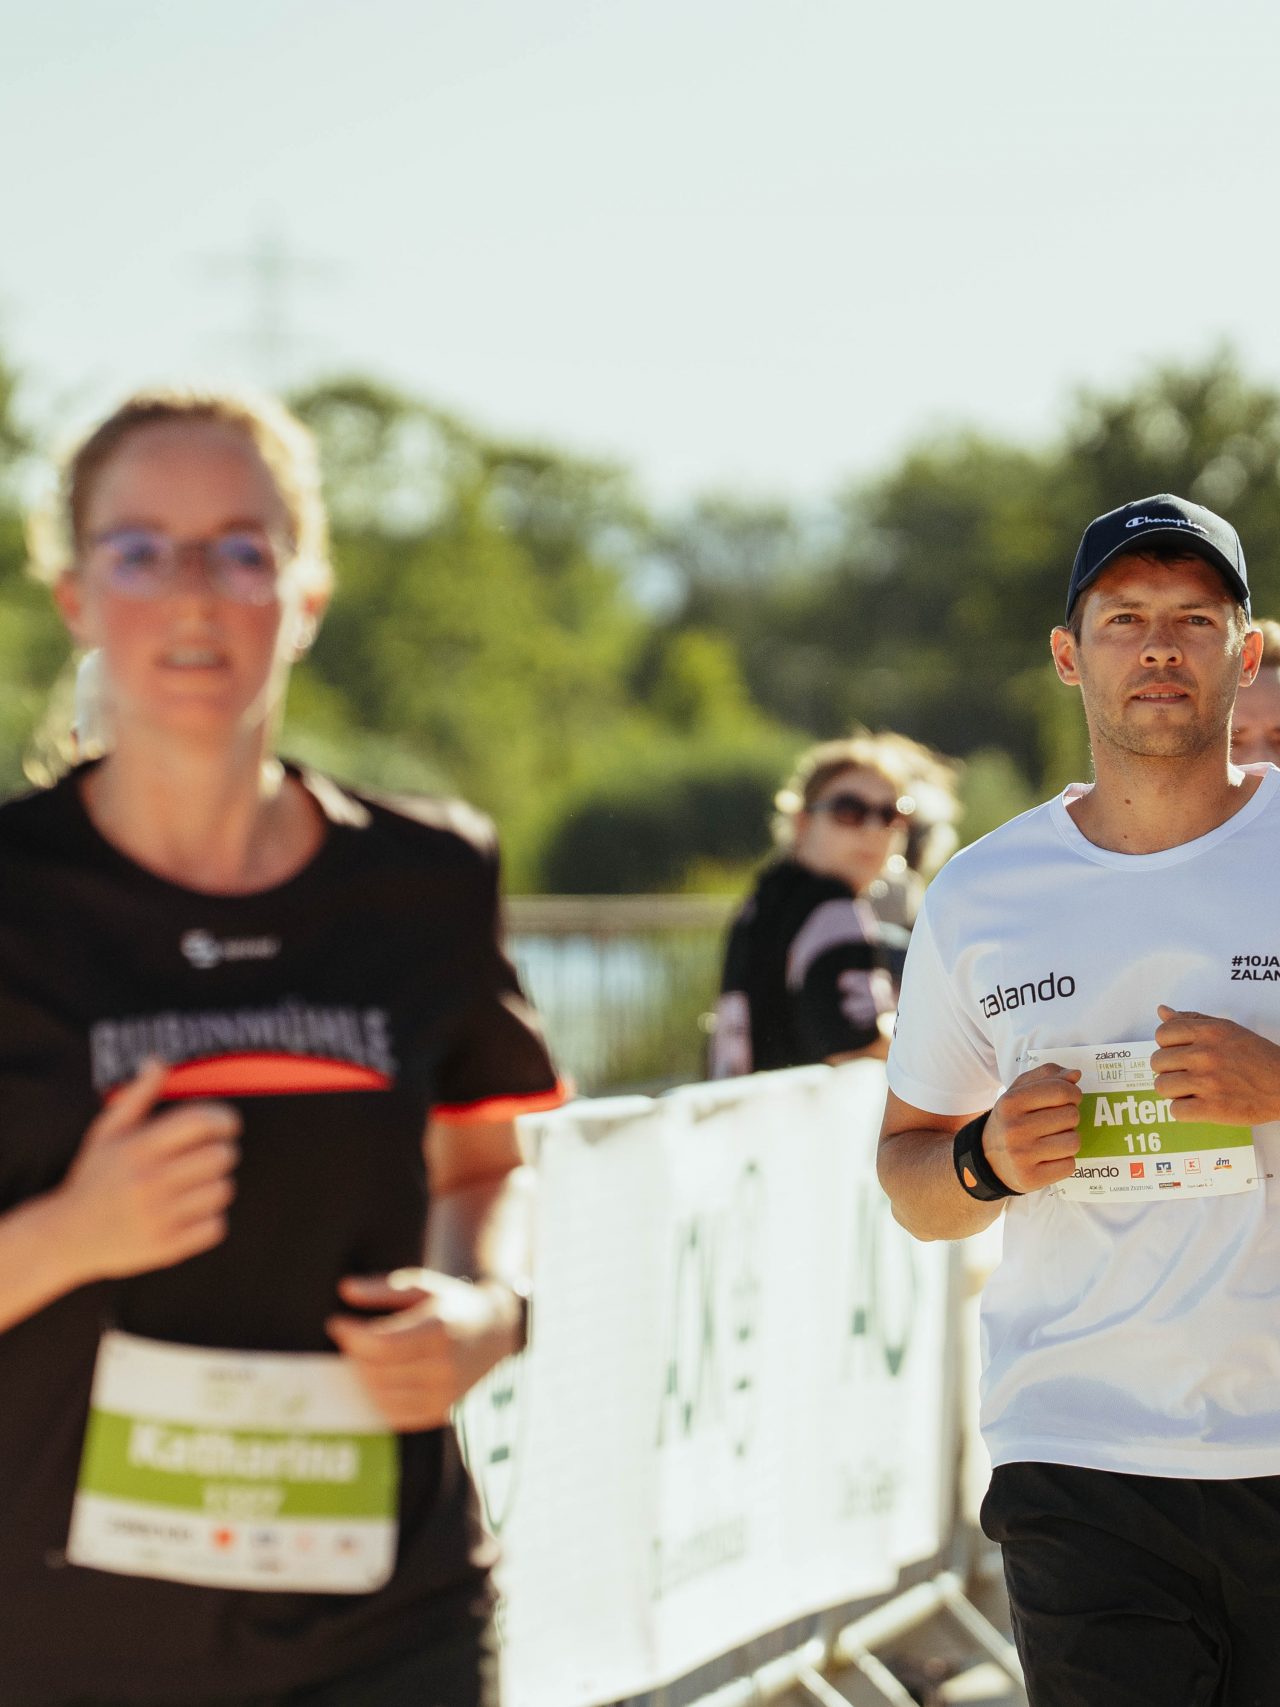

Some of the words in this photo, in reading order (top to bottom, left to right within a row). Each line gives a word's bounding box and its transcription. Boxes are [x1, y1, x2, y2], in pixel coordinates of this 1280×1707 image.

[980, 972, 1076, 1019] zalando
[1095, 1050, 1131, 1060] zalando
[1101, 1069, 1123, 1080] LAUF
[1124, 1132, 1161, 1153] 116
